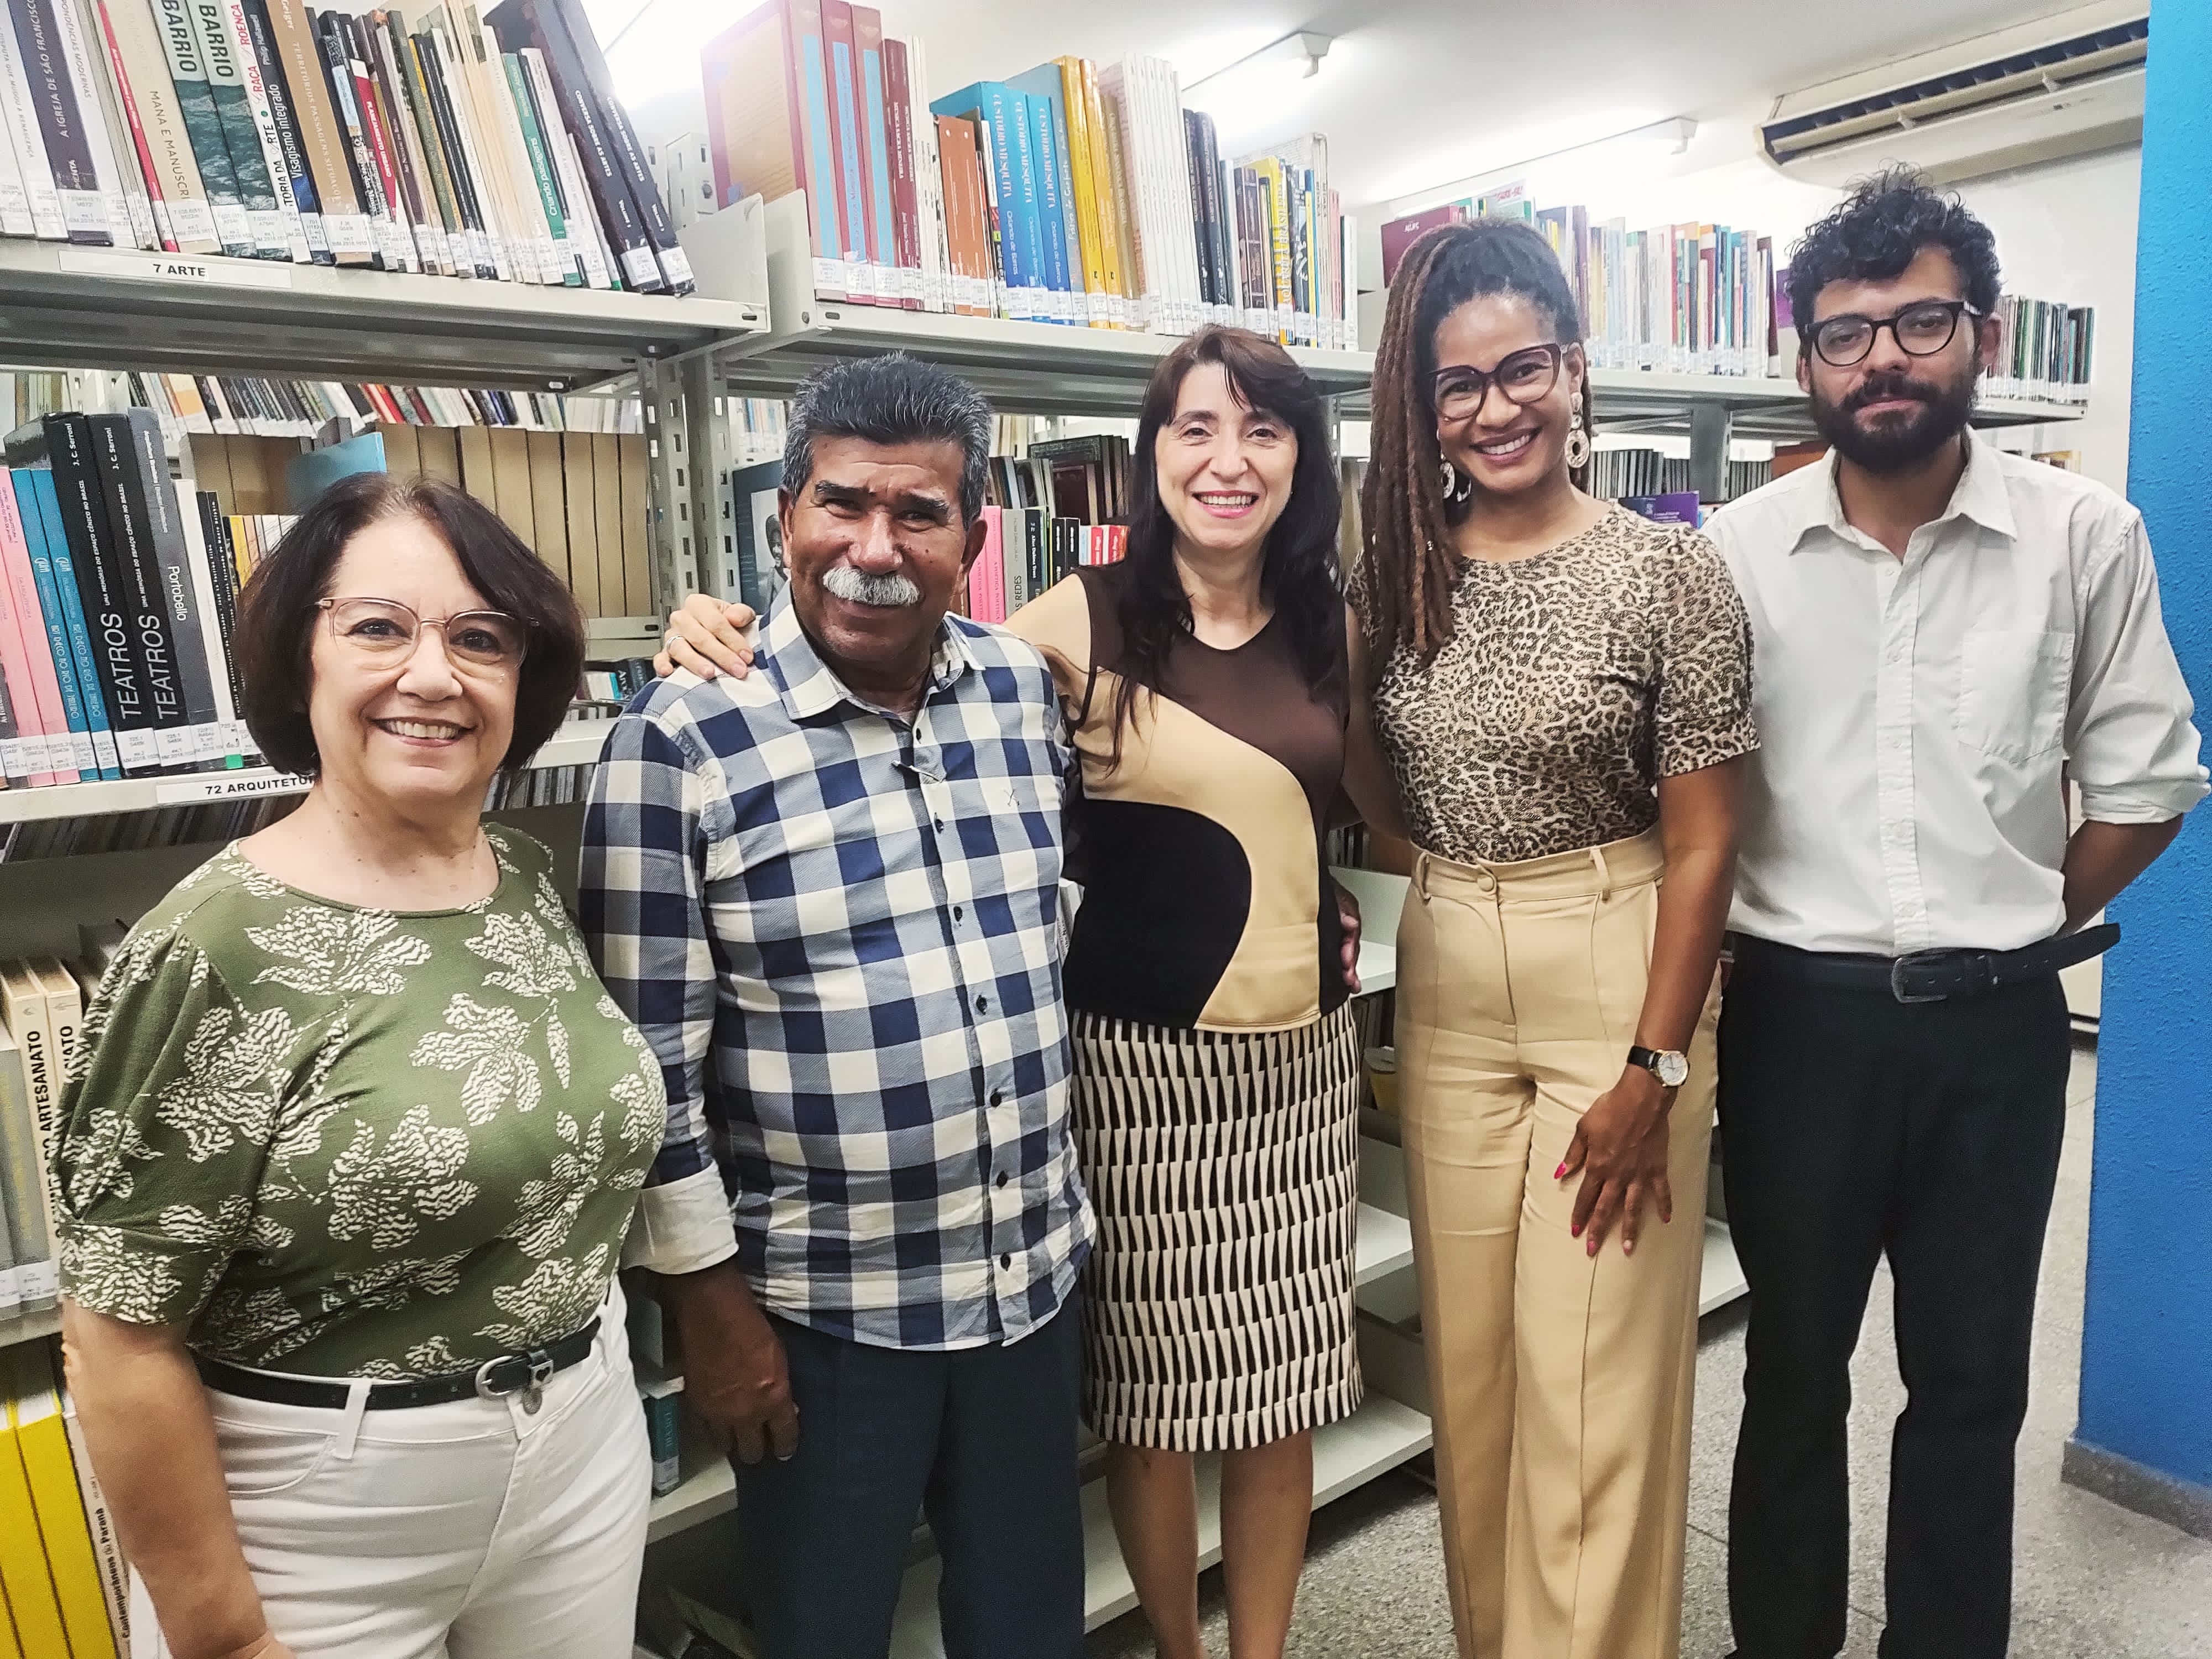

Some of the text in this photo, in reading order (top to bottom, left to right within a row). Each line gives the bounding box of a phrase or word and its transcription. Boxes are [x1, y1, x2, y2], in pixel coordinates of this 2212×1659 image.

[161, 0, 197, 72] BARRIO
[199, 4, 233, 77] BARRIO
[39, 53, 54, 75] SÃO
[45, 77, 58, 91] DE
[50, 93, 67, 128] IGREJA
[59, 129, 69, 138] A
[269, 84, 303, 179] Visagismo integrado
[576, 90, 612, 178] CONVERSA SOBRE AS ARTES
[607, 96, 645, 182] CONVERSA SOBRE AS ARTES
[530, 138, 557, 216] Criando paisagens
[153, 264, 206, 277] 7 ARTE
[65, 423, 76, 450] Serroni
[105, 427, 116, 453] Serroni
[79, 479, 87, 501] BRASIL
[118, 483, 127, 504] BRASIL
[83, 501, 89, 511] NO
[122, 504, 128, 514] NO
[88, 533, 100, 555] ESPAÇO
[128, 535, 138, 557] ESPAÇO
[95, 556, 101, 565] DO
[133, 557, 139, 567] DO
[96, 566, 107, 592] MEMÓRIA
[133, 567, 145, 593] MEMÓRIA
[168, 565, 187, 622] Portobello
[100, 613, 142, 719] TEATROS
[138, 614, 179, 719] TEATROS
[205, 785, 222, 795] 72
[27, 1030, 51, 1131] ARTESANATO
